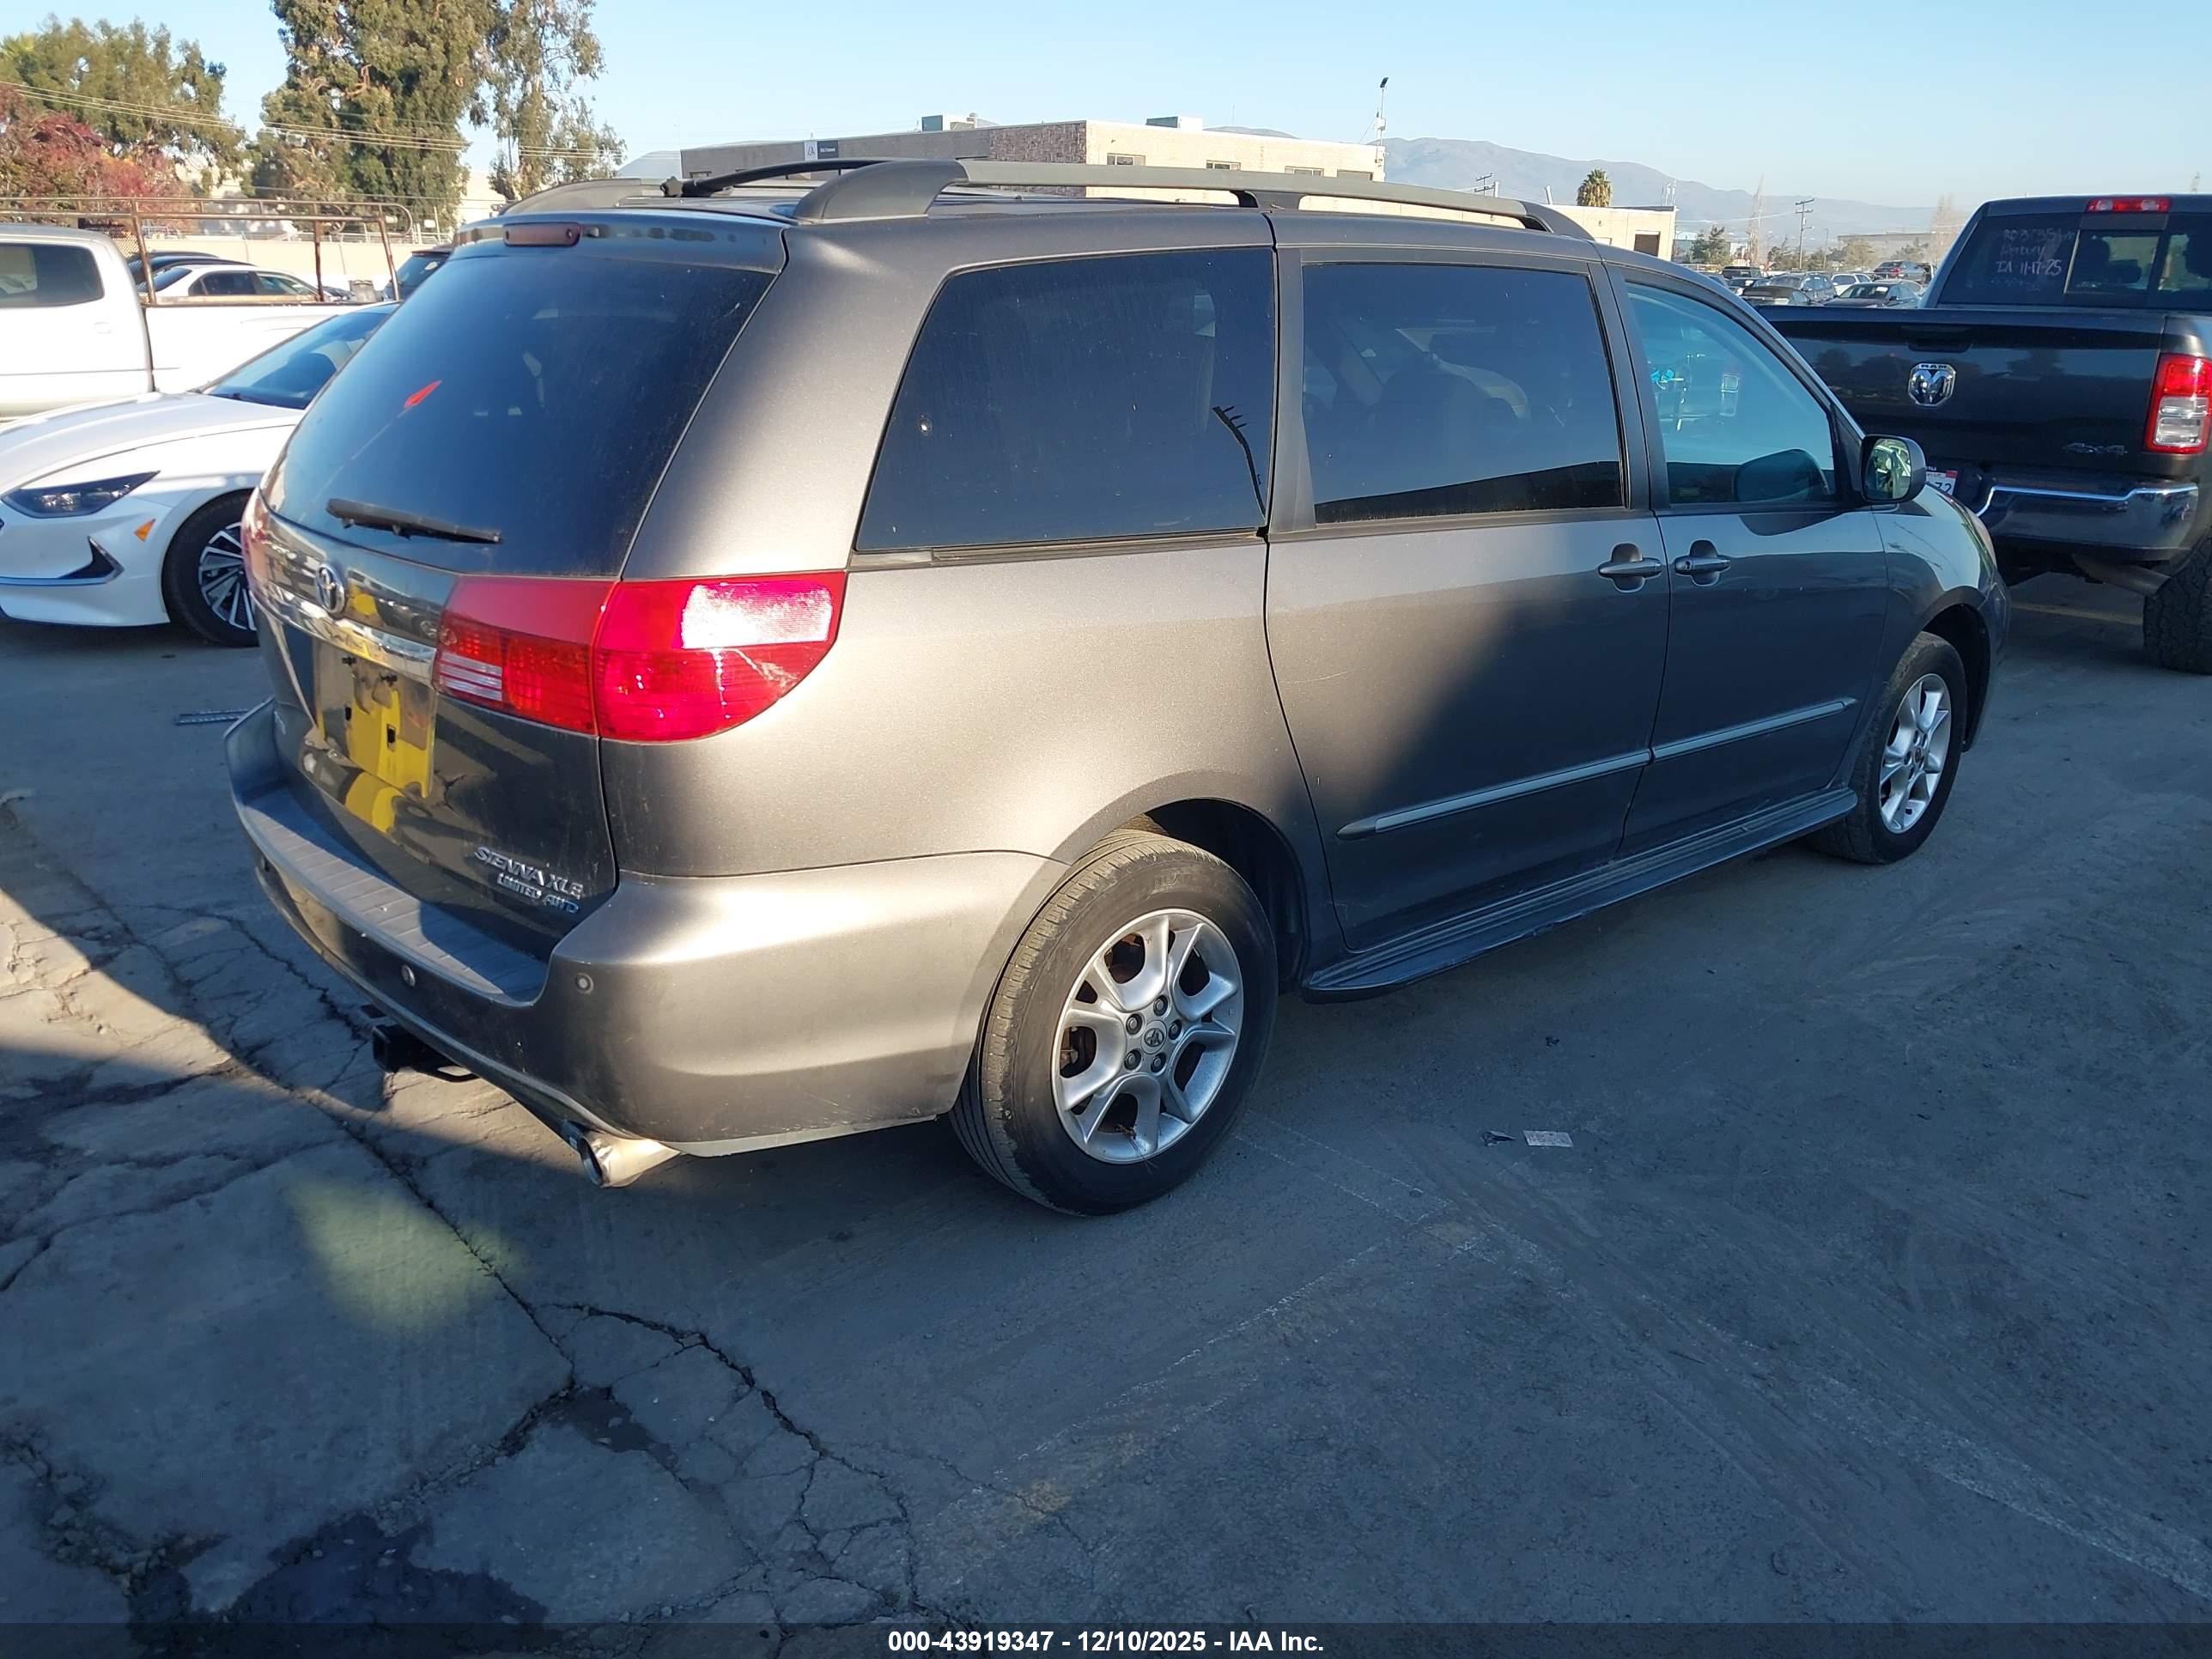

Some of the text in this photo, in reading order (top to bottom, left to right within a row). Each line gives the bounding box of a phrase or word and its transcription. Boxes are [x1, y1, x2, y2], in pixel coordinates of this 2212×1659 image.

[474, 846, 584, 900] SIENNA XLE
[542, 893, 580, 915] AWD
